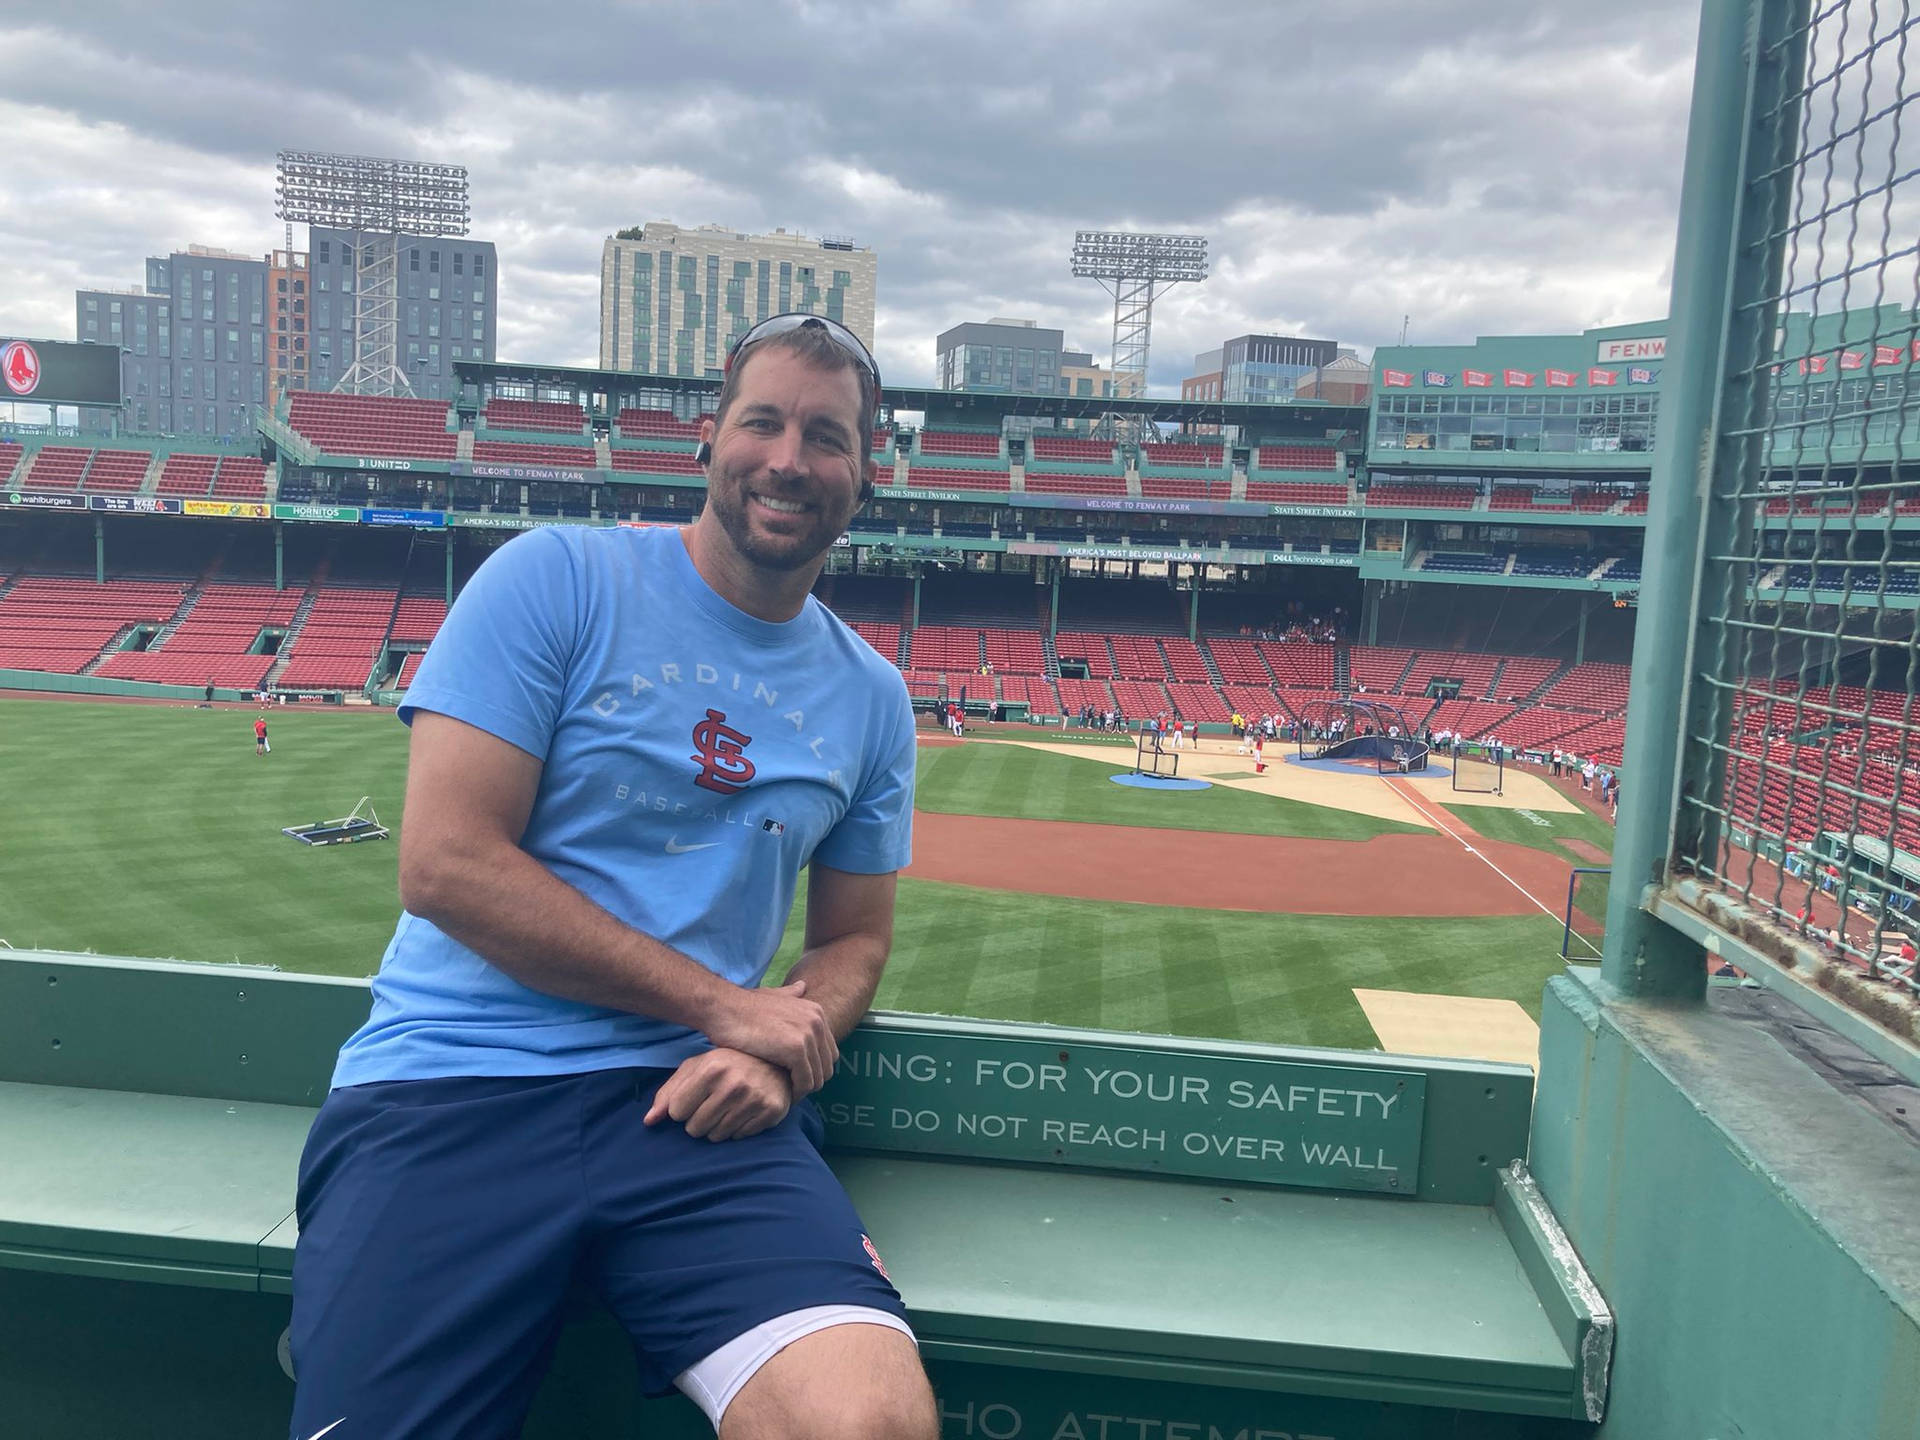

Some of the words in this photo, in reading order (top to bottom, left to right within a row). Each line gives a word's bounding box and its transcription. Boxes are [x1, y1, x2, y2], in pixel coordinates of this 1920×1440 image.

[370, 460, 411, 470] UNITED
[472, 466, 511, 477] WELCOME
[514, 467, 523, 477] TO
[526, 469, 560, 479] FENWAY
[562, 471, 584, 481] PARK
[882, 489, 901, 497] STATE
[903, 490, 926, 498] STREET
[928, 491, 960, 500] PAVILION
[22, 496, 72, 505] wahlburgers
[1086, 500, 1121, 508] WELCOME
[1124, 501, 1134, 509] TO
[1136, 502, 1168, 510] FENWAY
[1169, 503, 1190, 511] PARK
[293, 507, 340, 516] HORNITOS
[1274, 506, 1294, 514] STATE
[1296, 507, 1320, 515] STREET
[1323, 507, 1356, 516] PAVILION
[464, 518, 500, 526] AMERICA'S
[502, 519, 519, 527] MOST
[1066, 547, 1105, 556] AMERICA'S
[1107, 549, 1126, 557] MOST
[1128, 550, 1161, 558] BELOVED
[1163, 551, 1202, 560] BALLPARK
[1273, 554, 1292, 562] DELL
[1293, 555, 1334, 565] Technologies
[1335, 557, 1353, 565] Level
[615, 784, 754, 827] BASEALL
[976, 1060, 1067, 1092] FOR
[1085, 1068, 1210, 1104] YOUR
[1227, 1081, 1398, 1119] SAFETY
[891, 1109, 941, 1132] DO
[957, 1114, 1028, 1138] NOT
[1042, 1120, 1165, 1150] REACH
[1183, 1133, 1285, 1162] OVER
[1302, 1140, 1398, 1171] WALL
